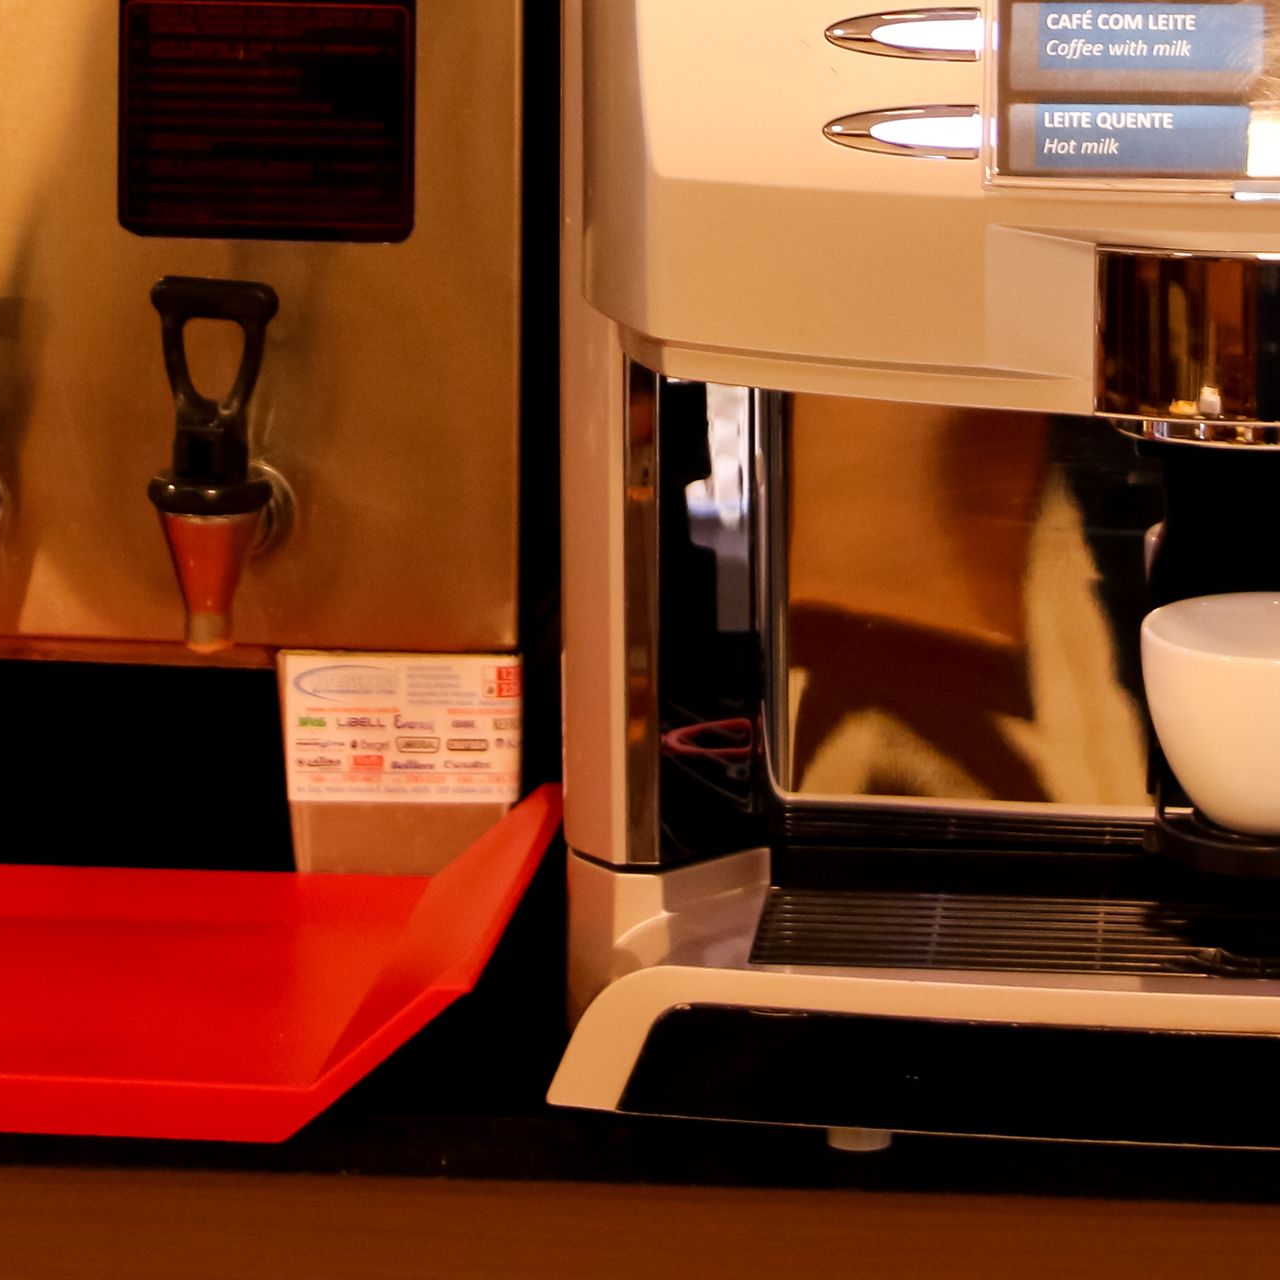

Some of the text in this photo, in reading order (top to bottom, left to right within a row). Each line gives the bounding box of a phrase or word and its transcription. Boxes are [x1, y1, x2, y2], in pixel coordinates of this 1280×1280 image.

[1046, 9, 1195, 31] CAFÉ COM LEITE
[1046, 38, 1192, 59] Coffee with milk
[1044, 111, 1173, 133] LEITE QUENTE
[1044, 136, 1120, 155] Hot milk
